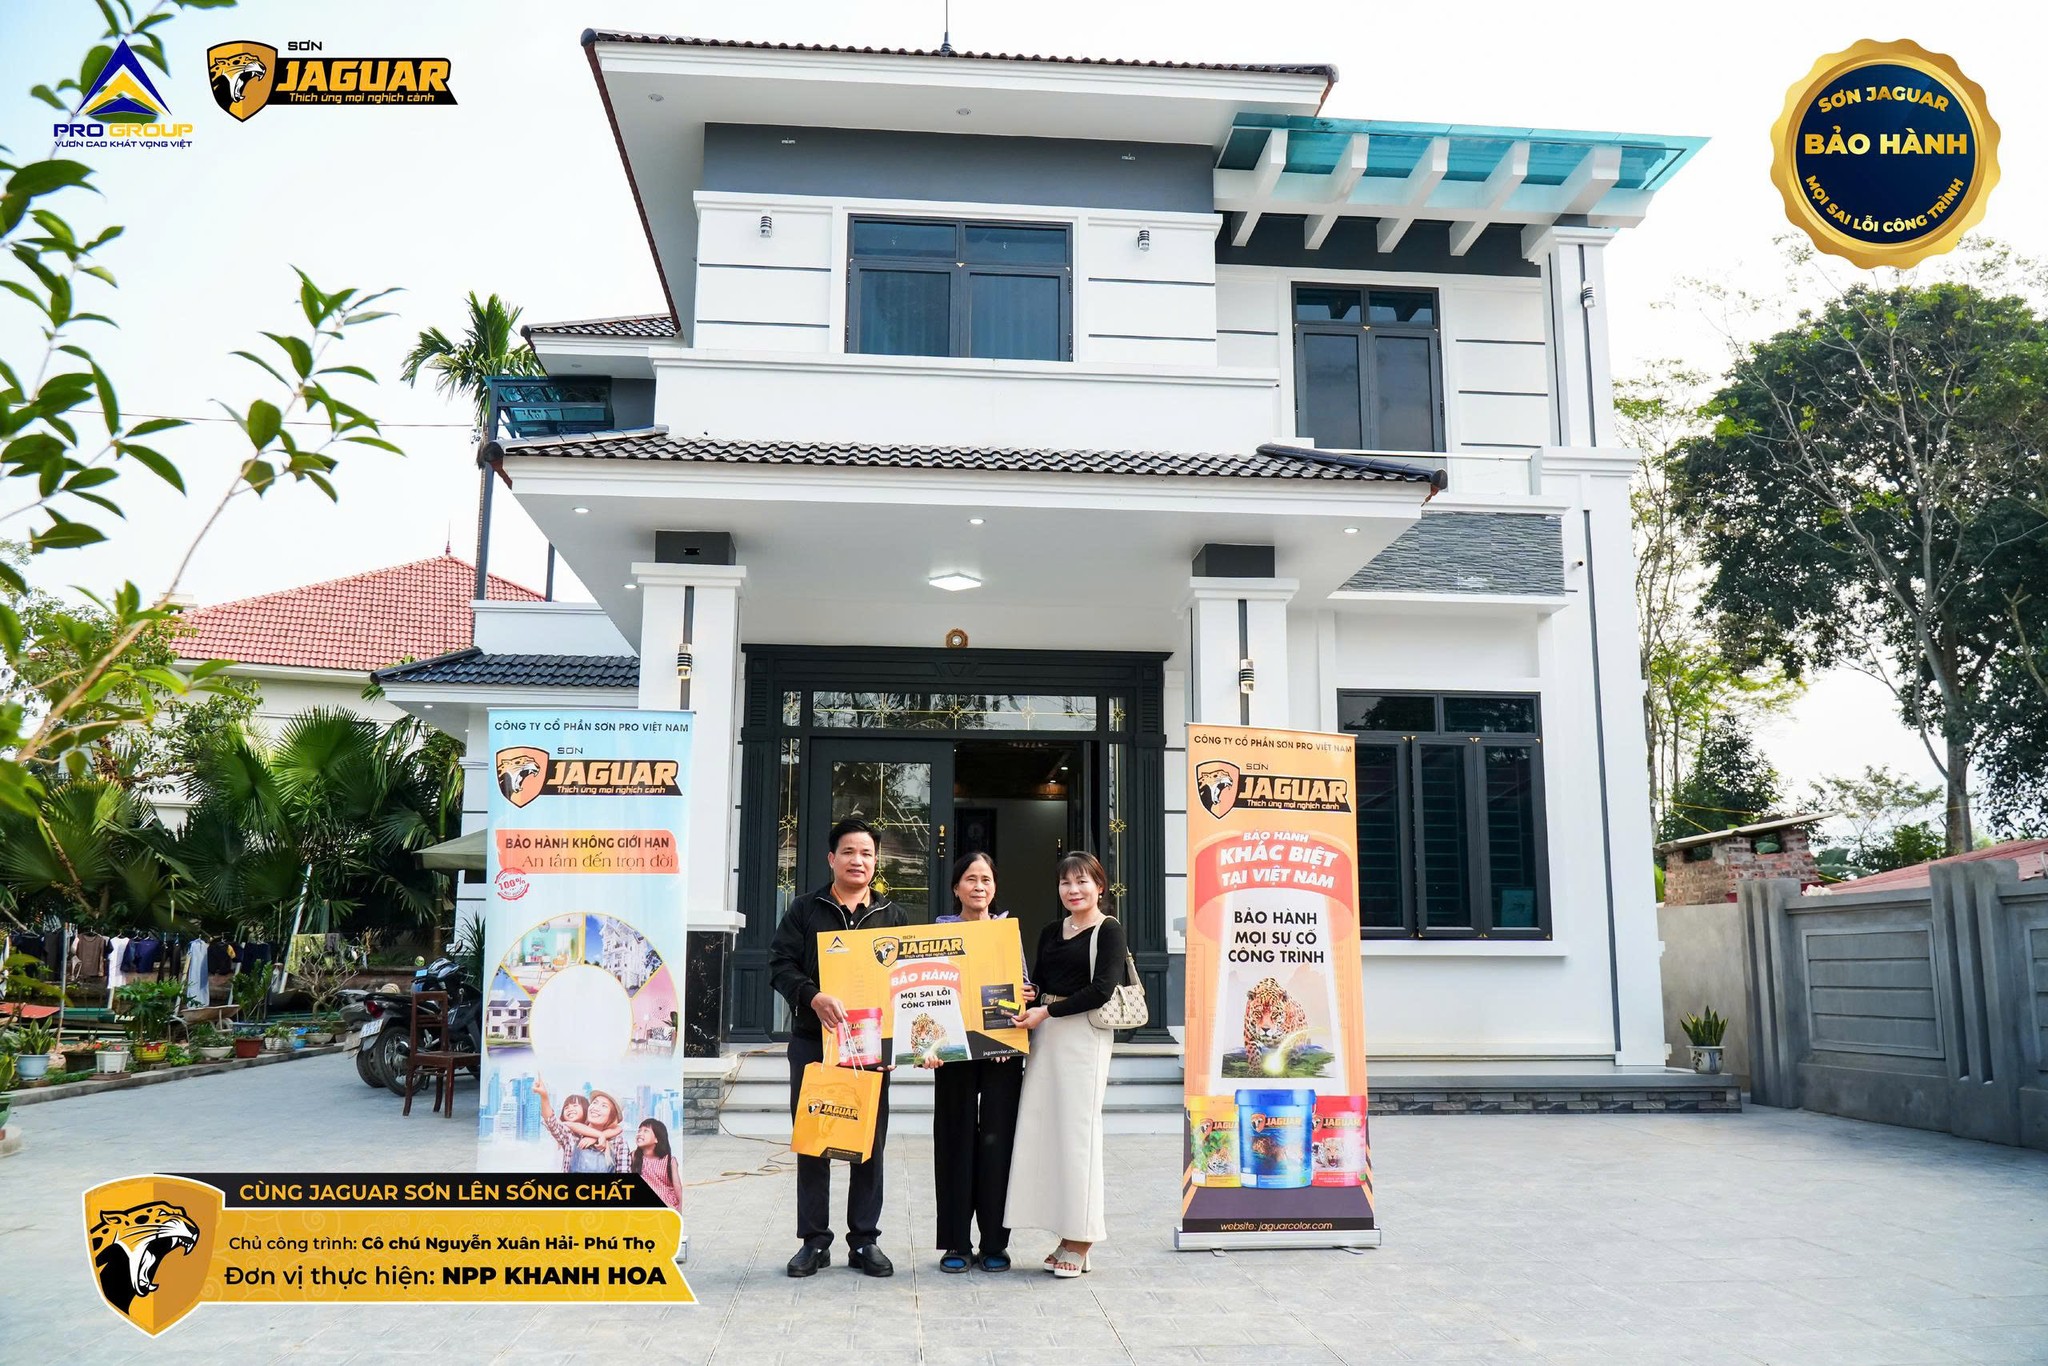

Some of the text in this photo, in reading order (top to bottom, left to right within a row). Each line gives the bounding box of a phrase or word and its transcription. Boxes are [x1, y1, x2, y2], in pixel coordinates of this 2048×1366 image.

[494, 718, 690, 734] CÔNG TY CỔ PHẦN SƠN PRO VIỆT NAM
[557, 747, 584, 755] SƠN
[1194, 734, 1222, 745] CÔNG
[1223, 737, 1233, 745] TY
[1276, 740, 1294, 749] SƠN
[1296, 742, 1313, 750] PRO
[1315, 742, 1333, 753] VIỆT
[1334, 744, 1352, 753] NAM
[546, 761, 678, 786] JAGUAR
[1245, 763, 1269, 771] SƠN
[556, 785, 579, 794] Thích
[580, 785, 597, 795] ứng
[615, 786, 643, 795] nghịch
[1238, 776, 1347, 803] JAGUAR
[505, 834, 669, 851] BẢO HÀNH KHÔNG GIỚI HẠN
[521, 851, 674, 871] An tâm đến trọn đời
[1220, 840, 1339, 870] KHÁC BIỆT
[499, 877, 526, 891] 100%
[1221, 865, 1335, 889] TẠI VIỆT NAM
[1234, 907, 1317, 925] BẢO HÀNH
[1234, 928, 1317, 947] MỌI SỰ CỐ
[899, 938, 963, 956] JAGUAR
[1228, 946, 1325, 964] CÔNG TRÌNH
[890, 969, 960, 986] BẢO HÀNH
[900, 992, 917, 1001] MỌI
[920, 990, 934, 998] SAI
[901, 999, 952, 1009] CÔNG TRÌNH
[821, 1104, 859, 1118] JAGUAR
[1264, 1117, 1302, 1126] JAGUAR
[1323, 1118, 1362, 1127] JAGUAR
[1220, 1221, 1333, 1232] website: jaguarcolor.com
